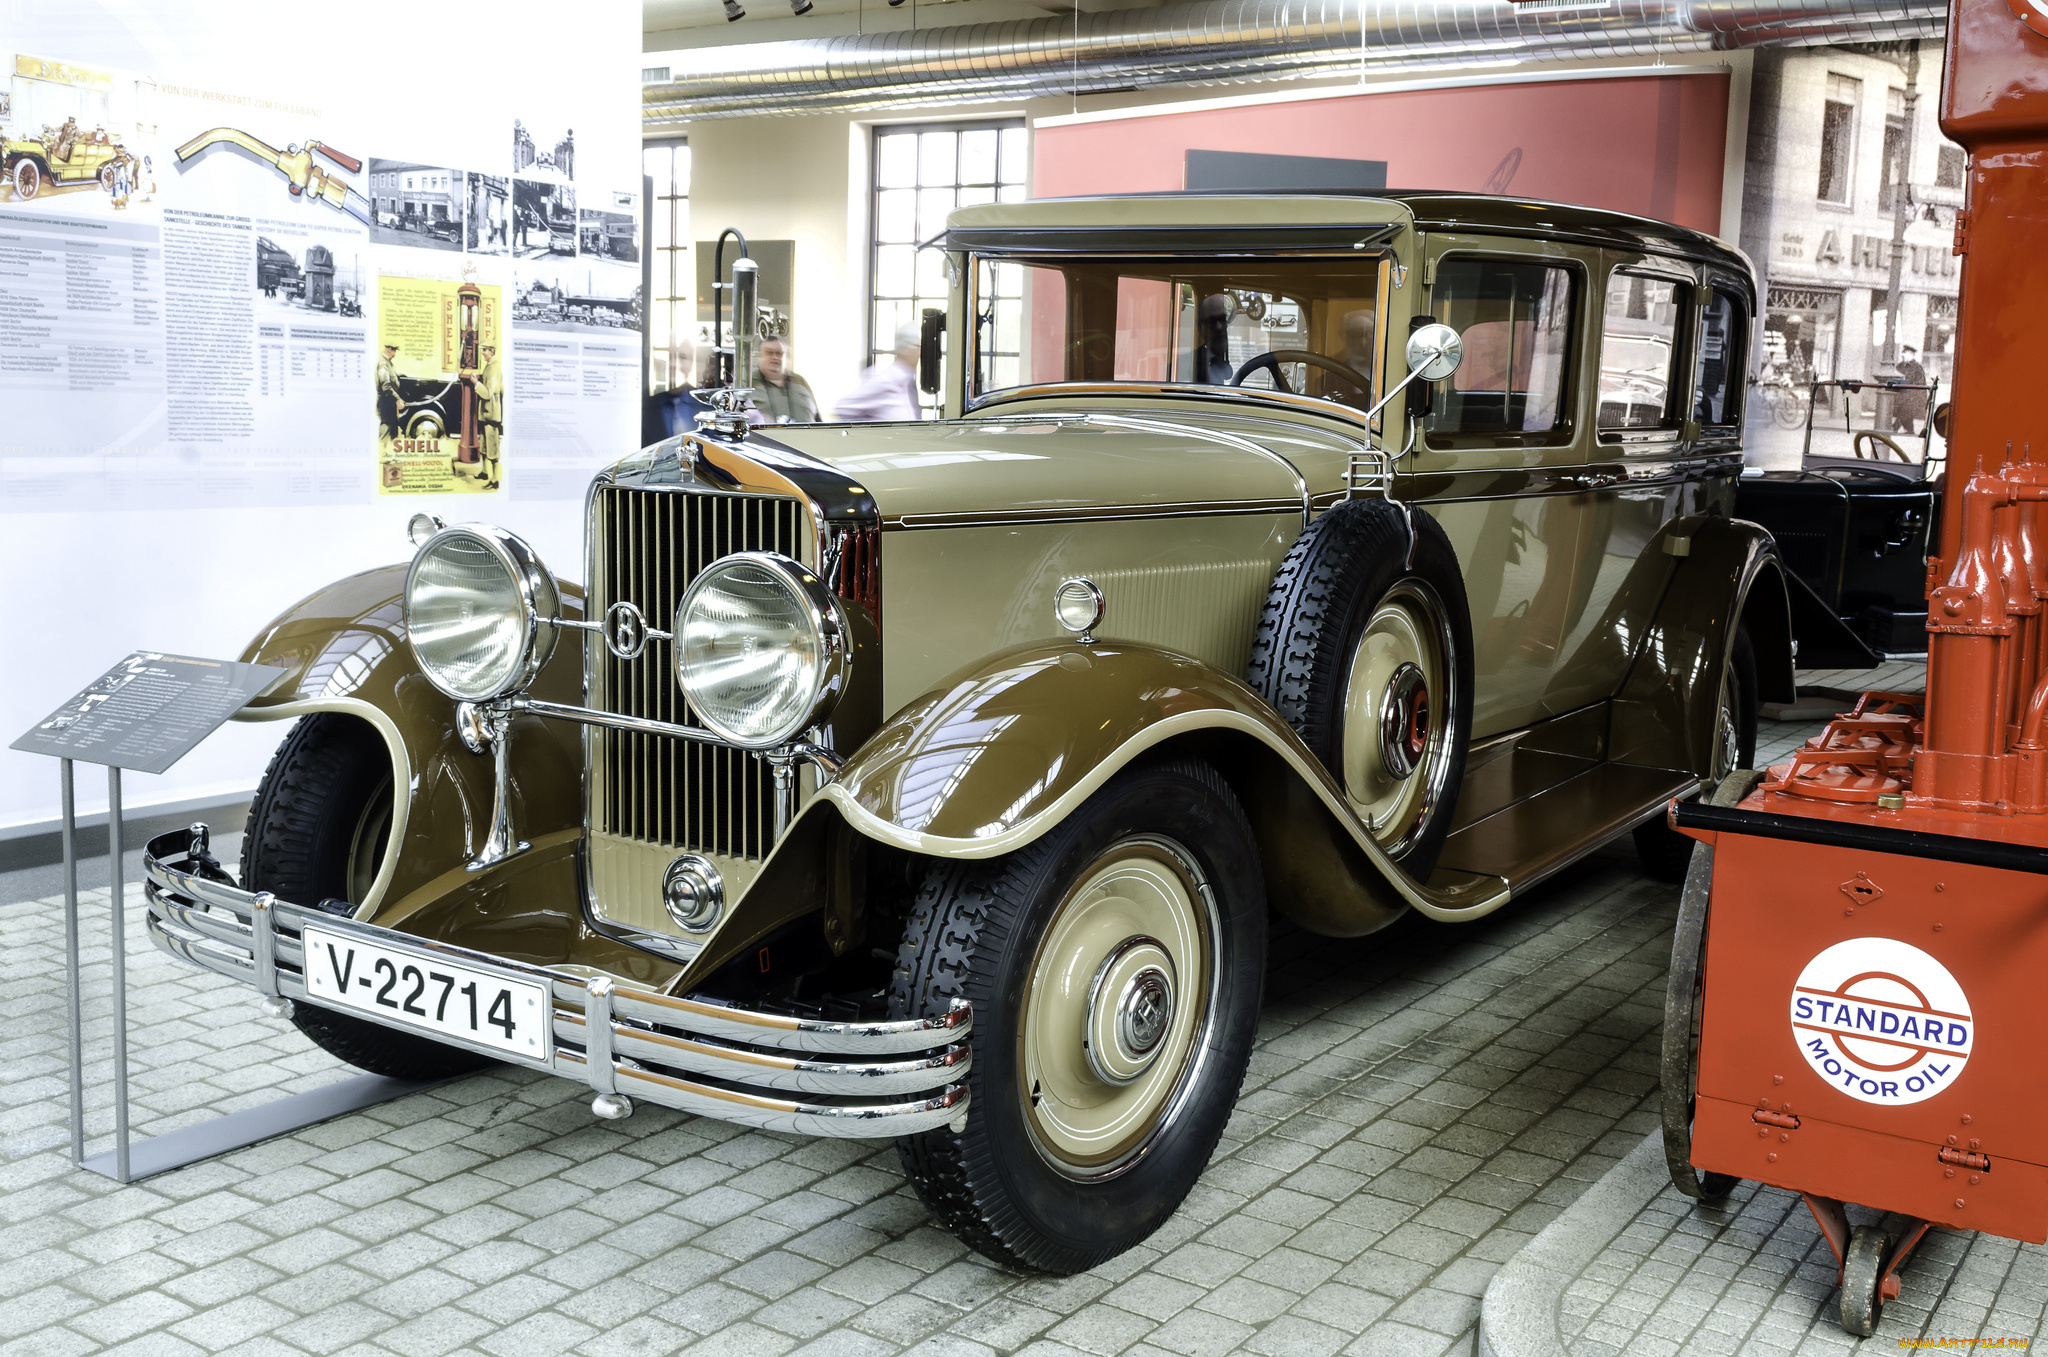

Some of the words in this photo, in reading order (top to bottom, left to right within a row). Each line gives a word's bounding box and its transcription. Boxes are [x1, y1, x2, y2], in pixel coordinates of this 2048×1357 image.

[161, 84, 180, 95] VON
[183, 87, 199, 98] DER
[202, 90, 252, 106] WERKSTATT
[254, 98, 272, 109] ZUM
[275, 102, 322, 118] FLIESSBAND
[393, 439, 440, 453] SHELL
[326, 943, 516, 1040] V-22714
[1795, 997, 1968, 1046] STANDARD
[1807, 1038, 1899, 1097] MOTOR
[1905, 1063, 1952, 1092] OIL
